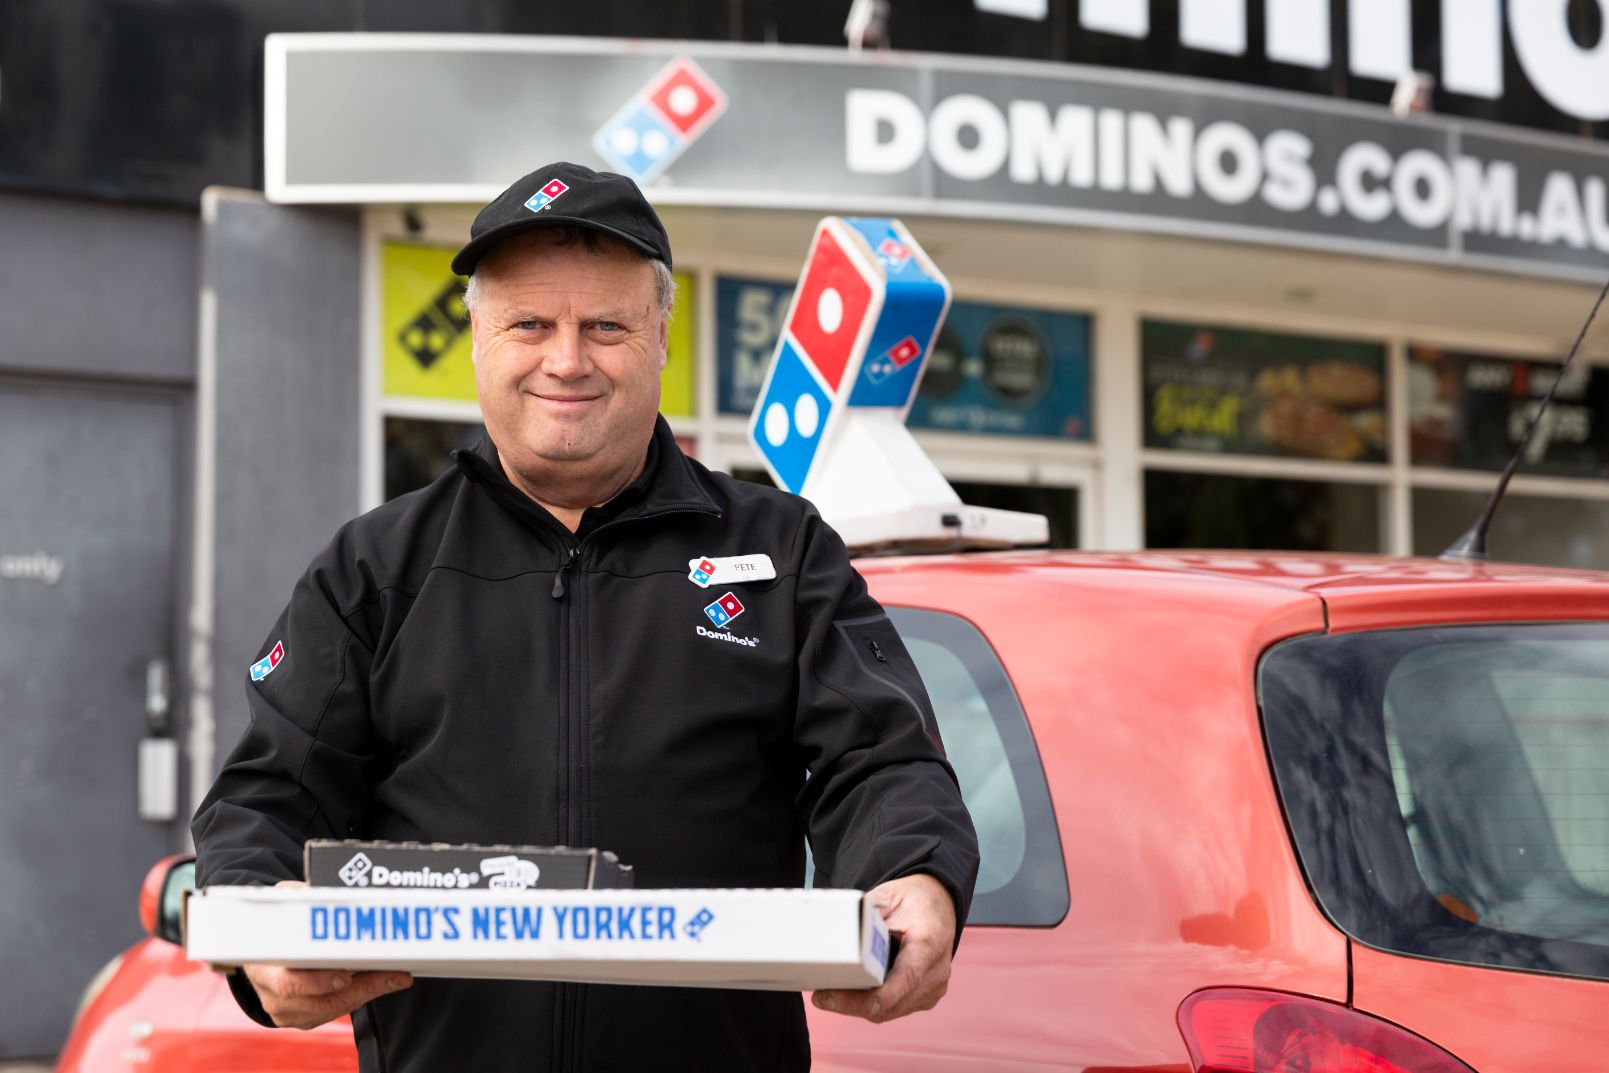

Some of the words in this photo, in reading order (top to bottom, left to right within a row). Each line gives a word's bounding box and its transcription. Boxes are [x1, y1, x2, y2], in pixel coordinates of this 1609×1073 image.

[734, 563, 757, 571] PETE
[696, 625, 756, 647] Domino's
[371, 865, 470, 888] Domino's
[310, 906, 460, 941] DOMINO'S
[472, 906, 543, 940] NEW
[553, 906, 677, 940] YORKER
